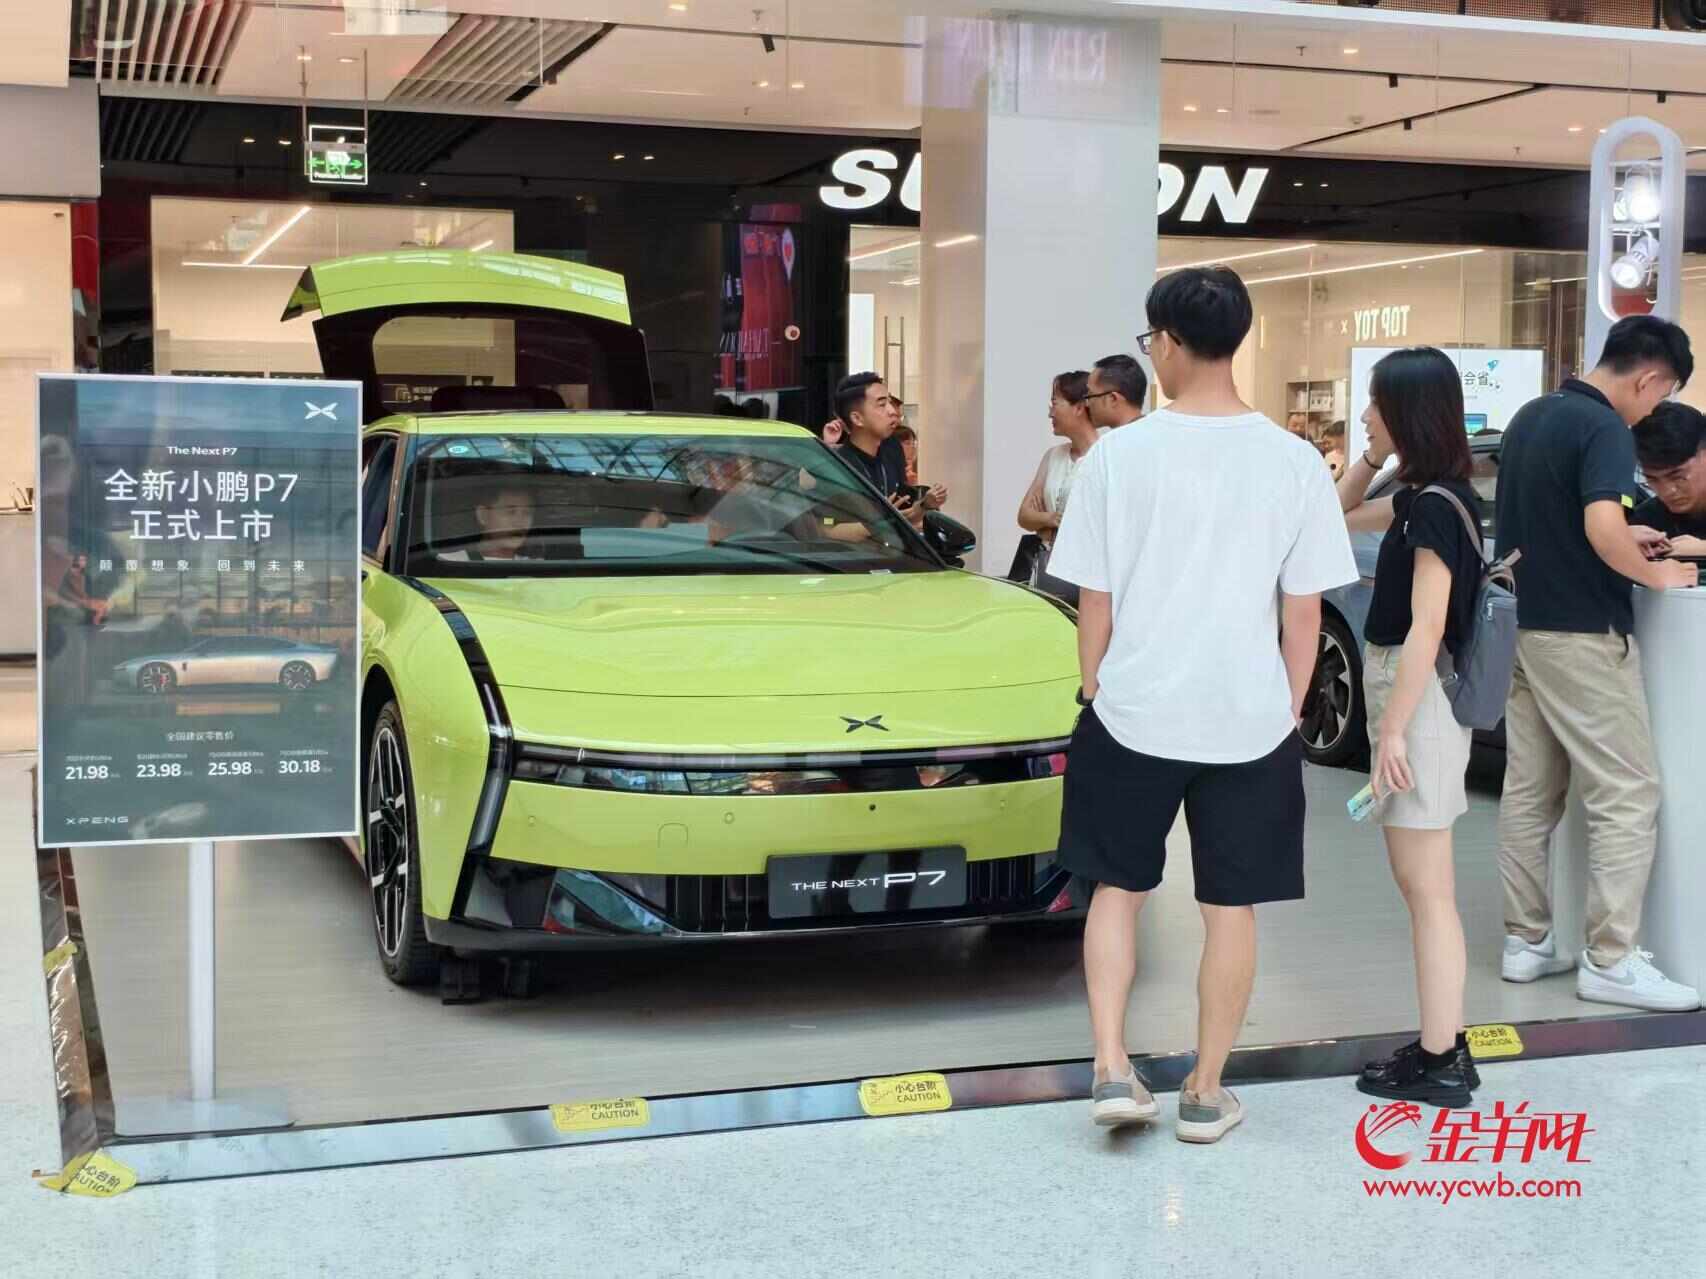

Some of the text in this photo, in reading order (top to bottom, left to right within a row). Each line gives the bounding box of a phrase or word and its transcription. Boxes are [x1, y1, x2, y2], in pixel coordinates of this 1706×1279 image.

[167, 446, 238, 455] The Next P7
[104, 468, 298, 502] 全新小鹏P7
[129, 508, 274, 541] 正式上市
[65, 765, 109, 780] 21.98
[136, 762, 181, 777] 23.98
[208, 761, 252, 775] 25.98
[279, 759, 321, 773] 30.18
[65, 815, 129, 825] XPENG
[791, 870, 947, 891] THE NEXT P7
[897, 1092, 940, 1103] CAUTION
[591, 1109, 639, 1120] CAUTION
